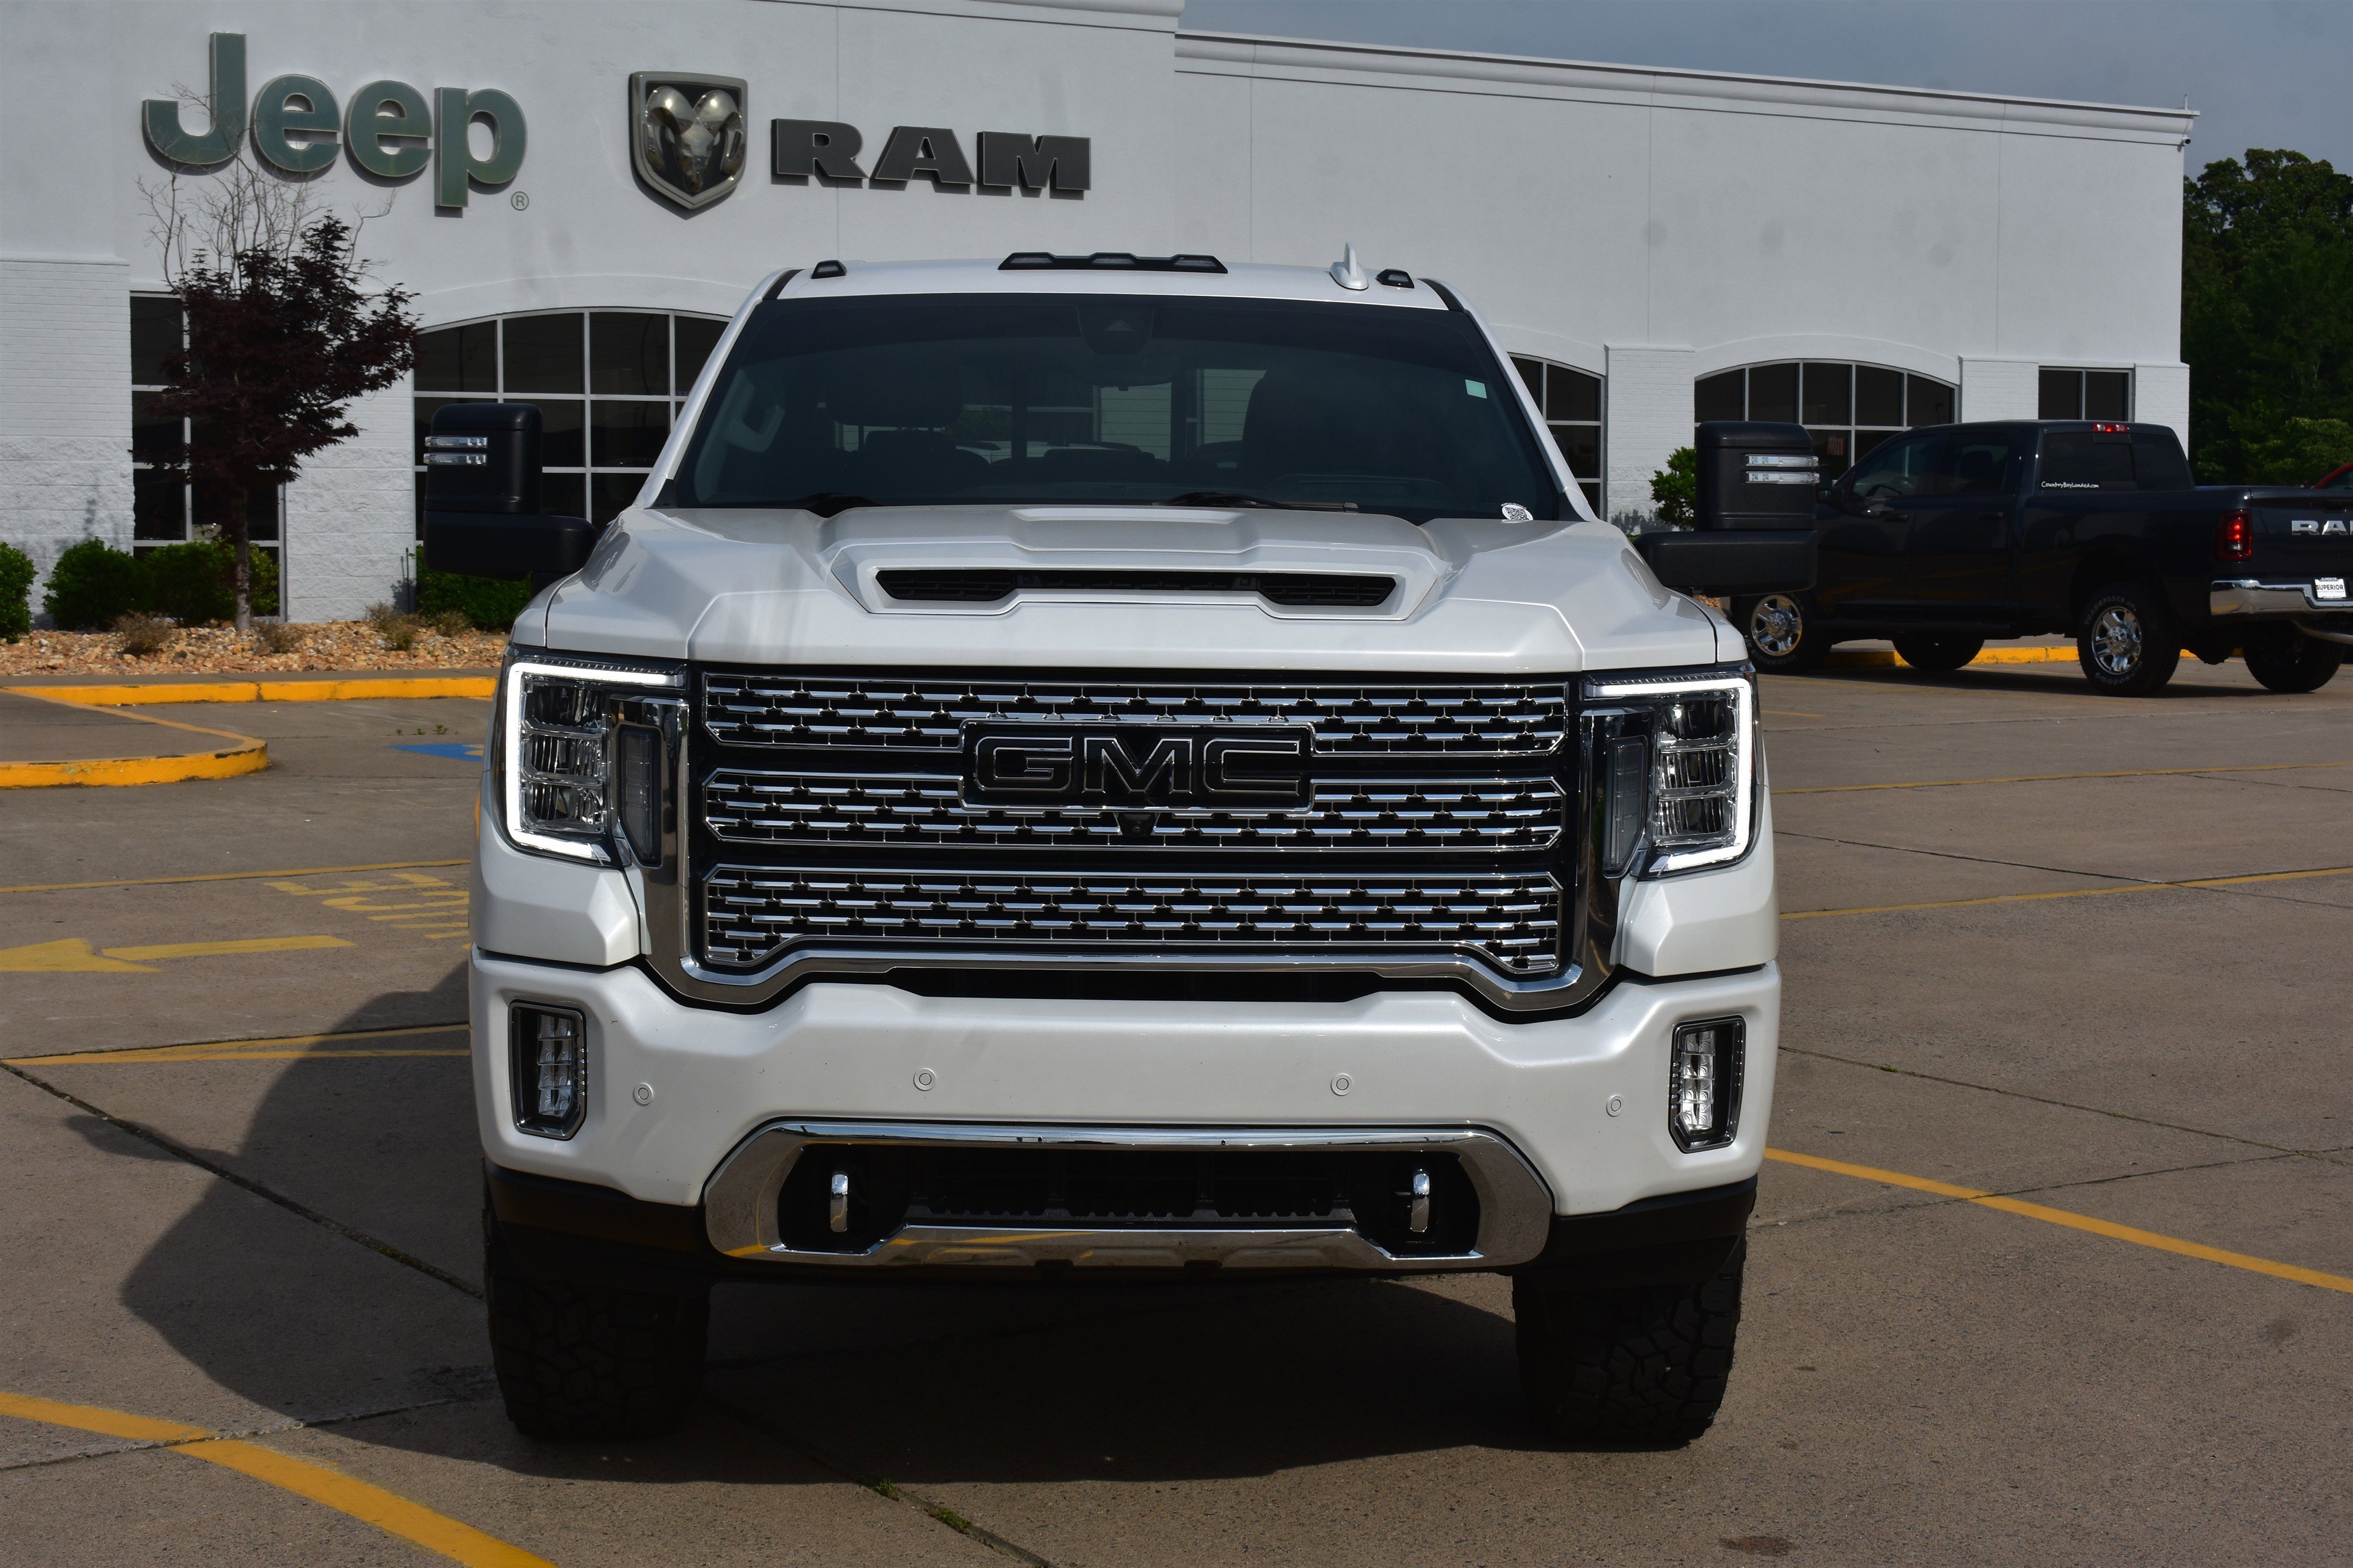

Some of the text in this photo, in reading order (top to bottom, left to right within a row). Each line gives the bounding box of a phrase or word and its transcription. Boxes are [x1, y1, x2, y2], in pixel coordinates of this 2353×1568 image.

[142, 31, 527, 209] Jeep
[771, 118, 1091, 191] RAM
[2291, 520, 2353, 535] RA
[975, 735, 1302, 797] GMC
